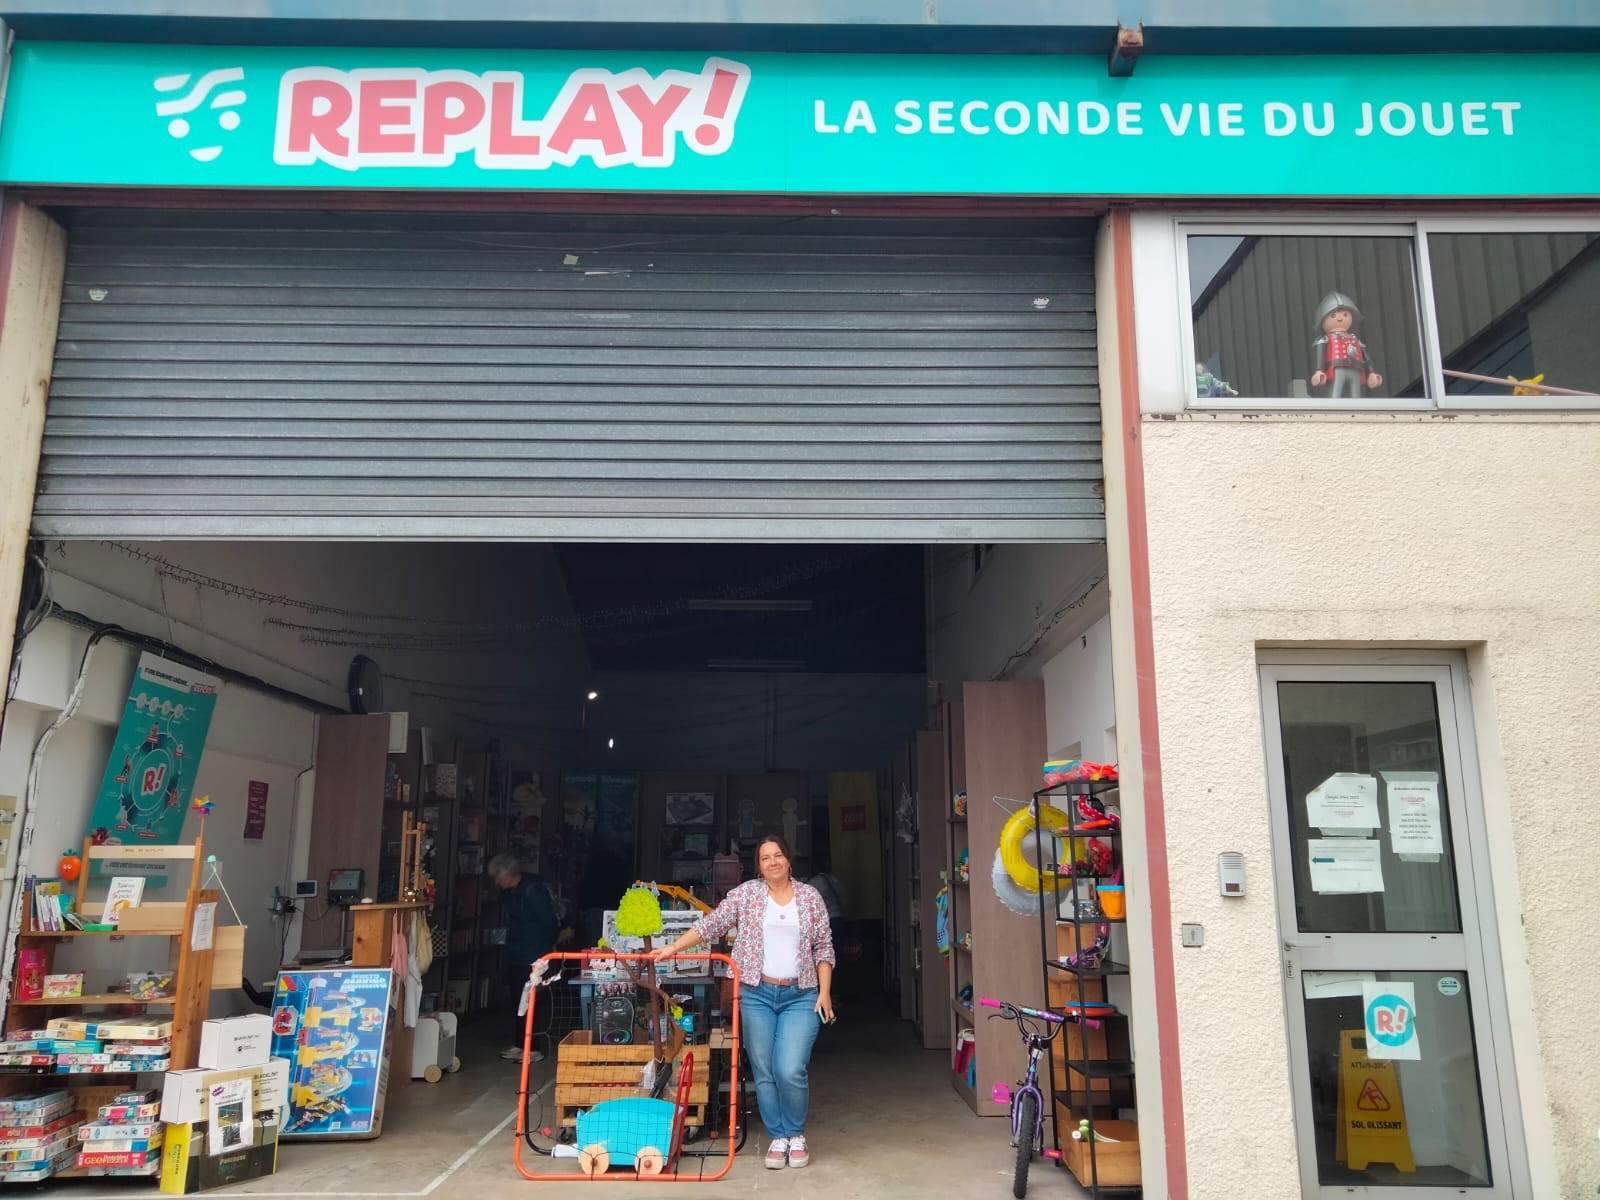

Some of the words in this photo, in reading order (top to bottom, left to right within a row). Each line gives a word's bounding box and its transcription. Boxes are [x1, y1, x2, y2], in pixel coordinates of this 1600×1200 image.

[284, 64, 742, 161] REPLAY!
[813, 99, 877, 134] LA
[894, 100, 1144, 136] SECONDE
[1159, 102, 1245, 137] VIE
[1263, 102, 1335, 137] DU
[1354, 101, 1522, 137] JOUET
[142, 765, 167, 796] R!
[1375, 1007, 1408, 1035] R!
[1351, 1120, 1365, 1129] SOL
[1366, 1121, 1403, 1131] GLISSANT
